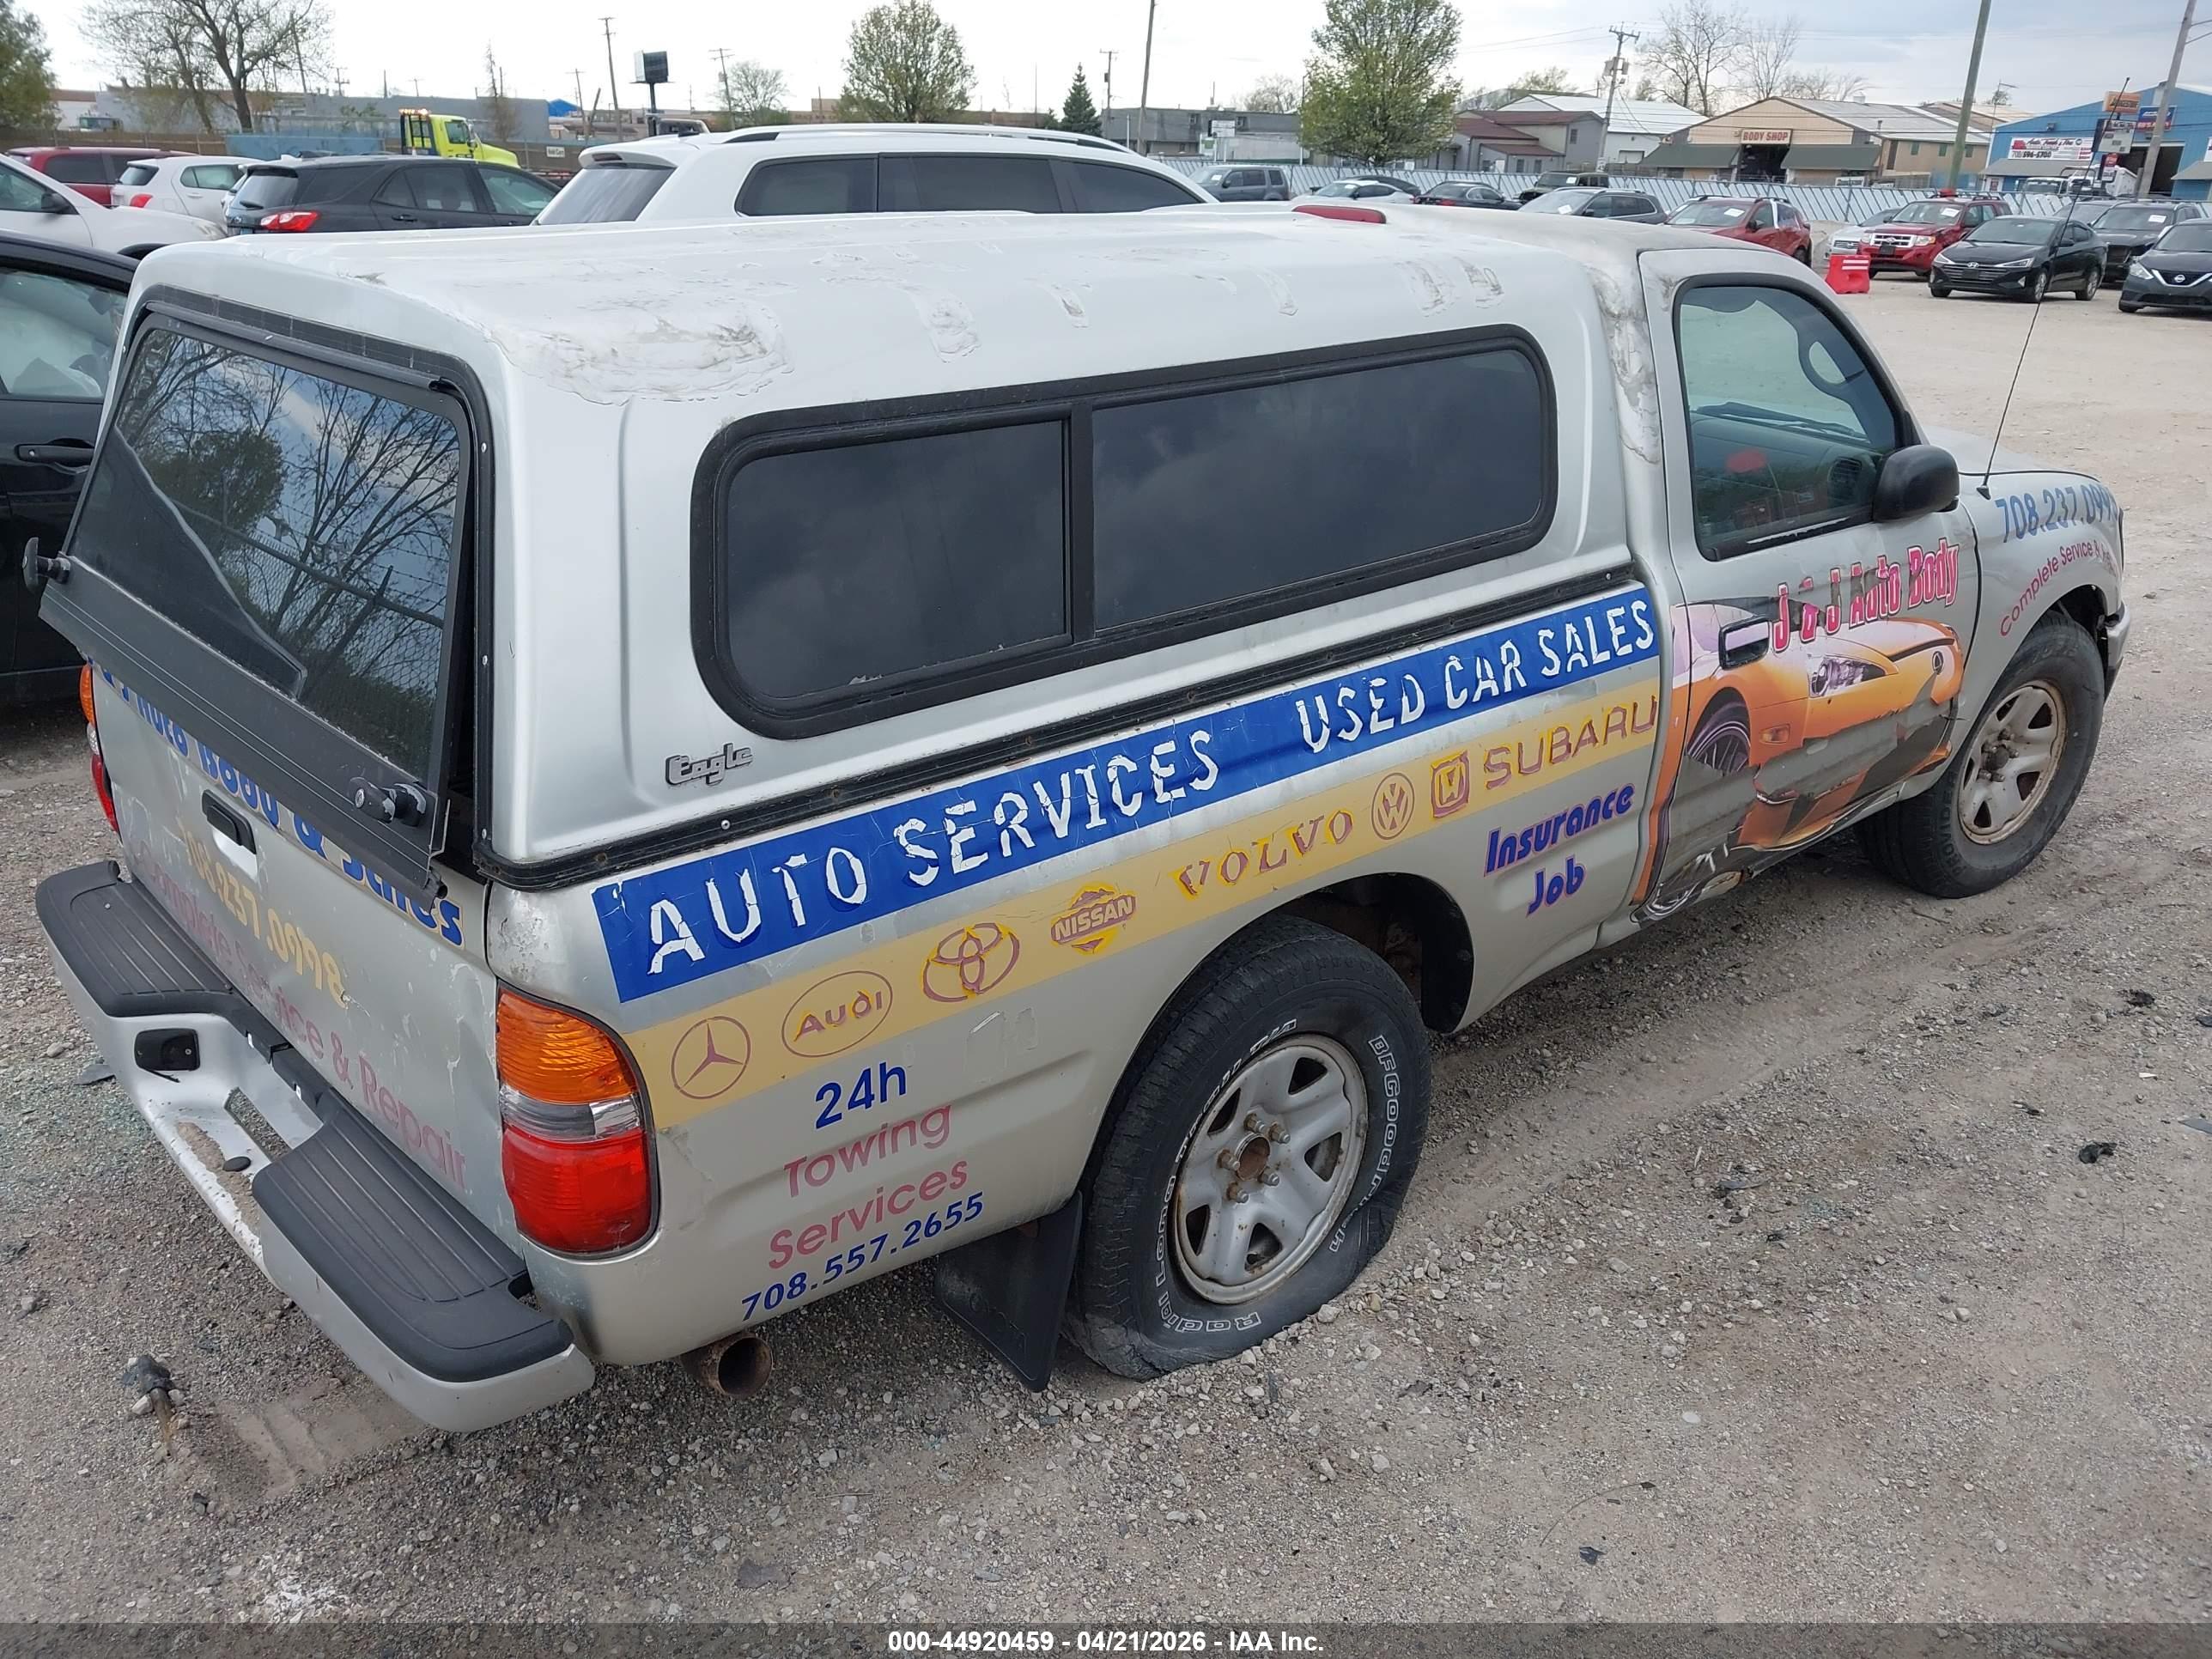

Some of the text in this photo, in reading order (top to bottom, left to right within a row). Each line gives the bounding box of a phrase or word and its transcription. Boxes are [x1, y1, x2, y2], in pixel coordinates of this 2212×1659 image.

[1743, 131, 1789, 141] BODY SHOP
[1772, 582, 1790, 653] J
[1850, 556, 1902, 629] Auto
[1907, 538, 1960, 610] Body
[1999, 556, 2059, 637] Complete
[2059, 541, 2094, 566] Service
[647, 599, 1656, 975] AUTO SERVICES USED CAR SALES
[665, 744, 754, 787] Eagle
[1484, 695, 1657, 790] SUBARU
[1176, 810, 1352, 896] VOLVO
[1484, 782, 1635, 877] Insurance
[1053, 890, 1133, 940] NISSAN
[1528, 857, 1586, 917] Job
[358, 1054, 467, 1190] Repair
[815, 1061, 907, 1129] 24h
[783, 1104, 952, 1198] Towing
[742, 1191, 984, 1322] 708.557.2655
[769, 1159, 968, 1270] Services
[1158, 1291, 1261, 1332] Radial
